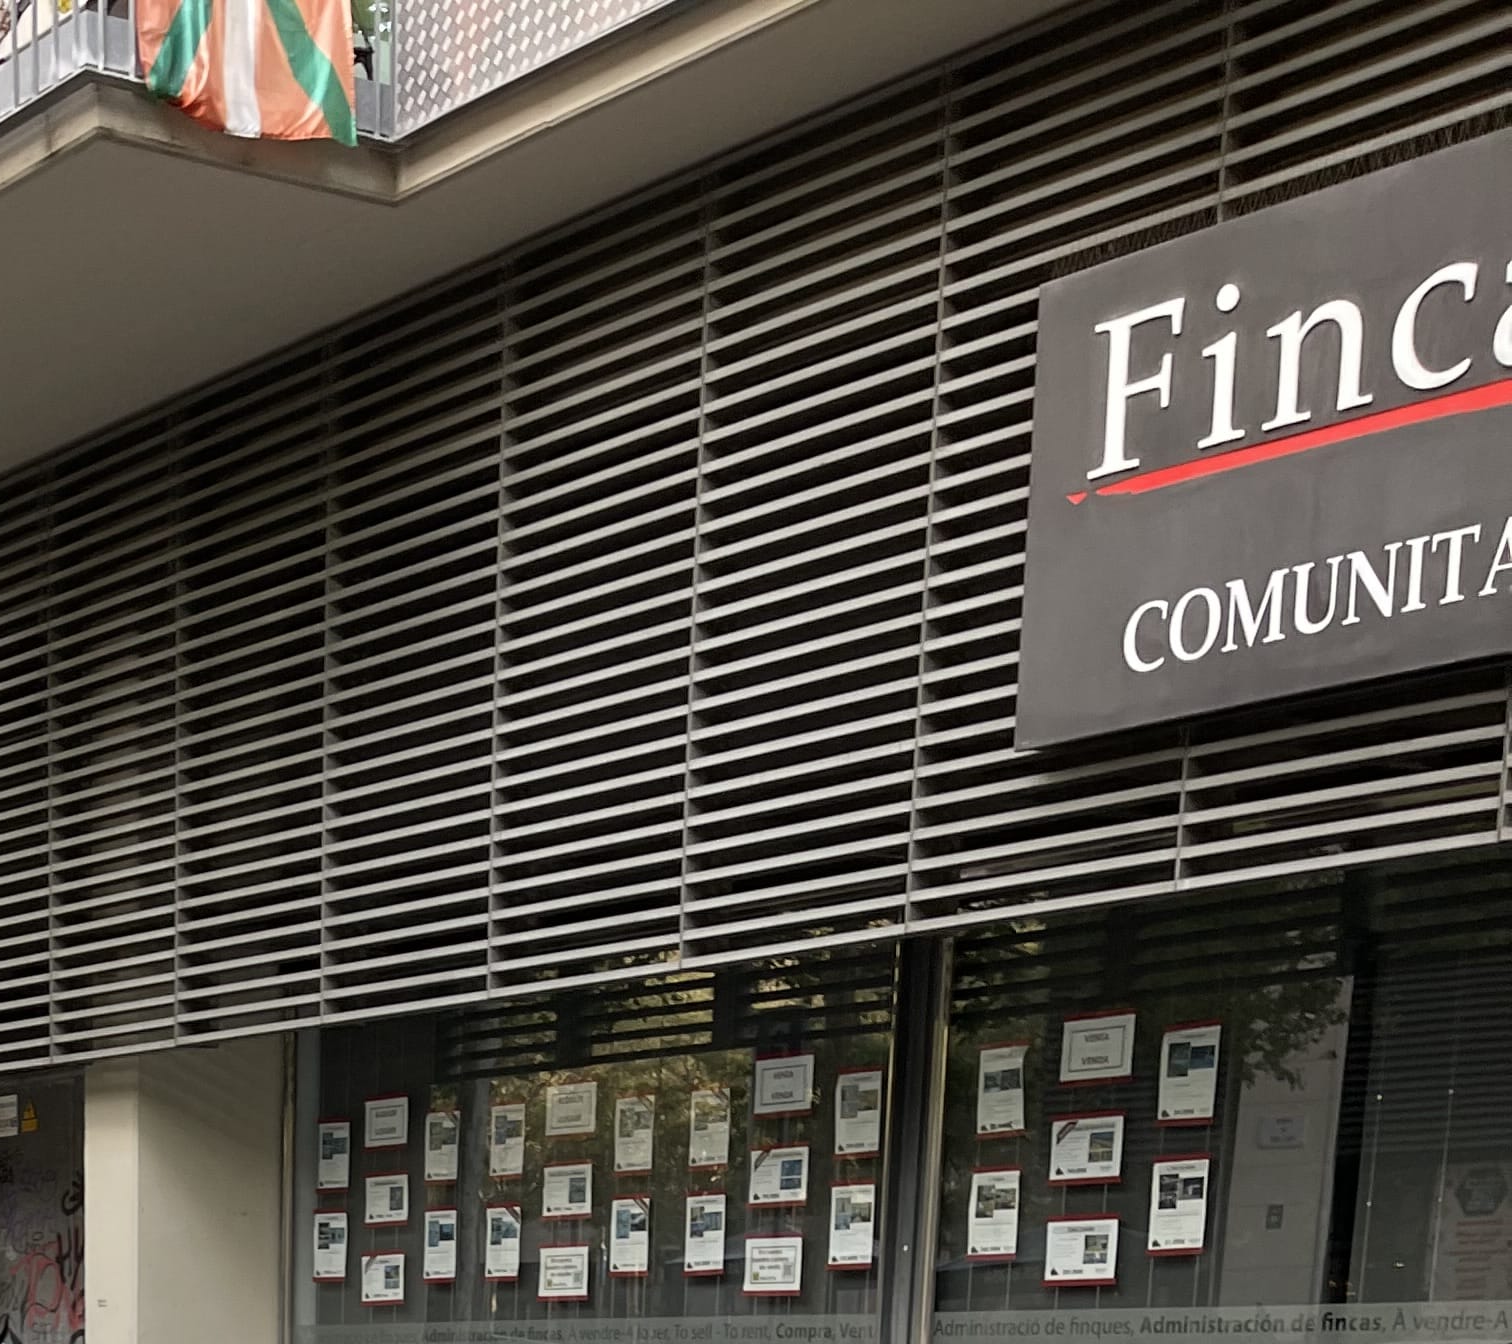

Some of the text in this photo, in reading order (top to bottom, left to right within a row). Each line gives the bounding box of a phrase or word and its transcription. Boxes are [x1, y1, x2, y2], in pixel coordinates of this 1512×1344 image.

[1087, 259, 1512, 480] Finc
[776, 1323, 835, 1343] Compra,
[934, 1318, 1039, 1337] Administració
[1044, 1317, 1064, 1336] de
[1069, 1316, 1135, 1339] finques,
[1140, 1312, 1284, 1336] Administración
[1291, 1312, 1315, 1332] de
[1321, 1311, 1386, 1334] fincas,
